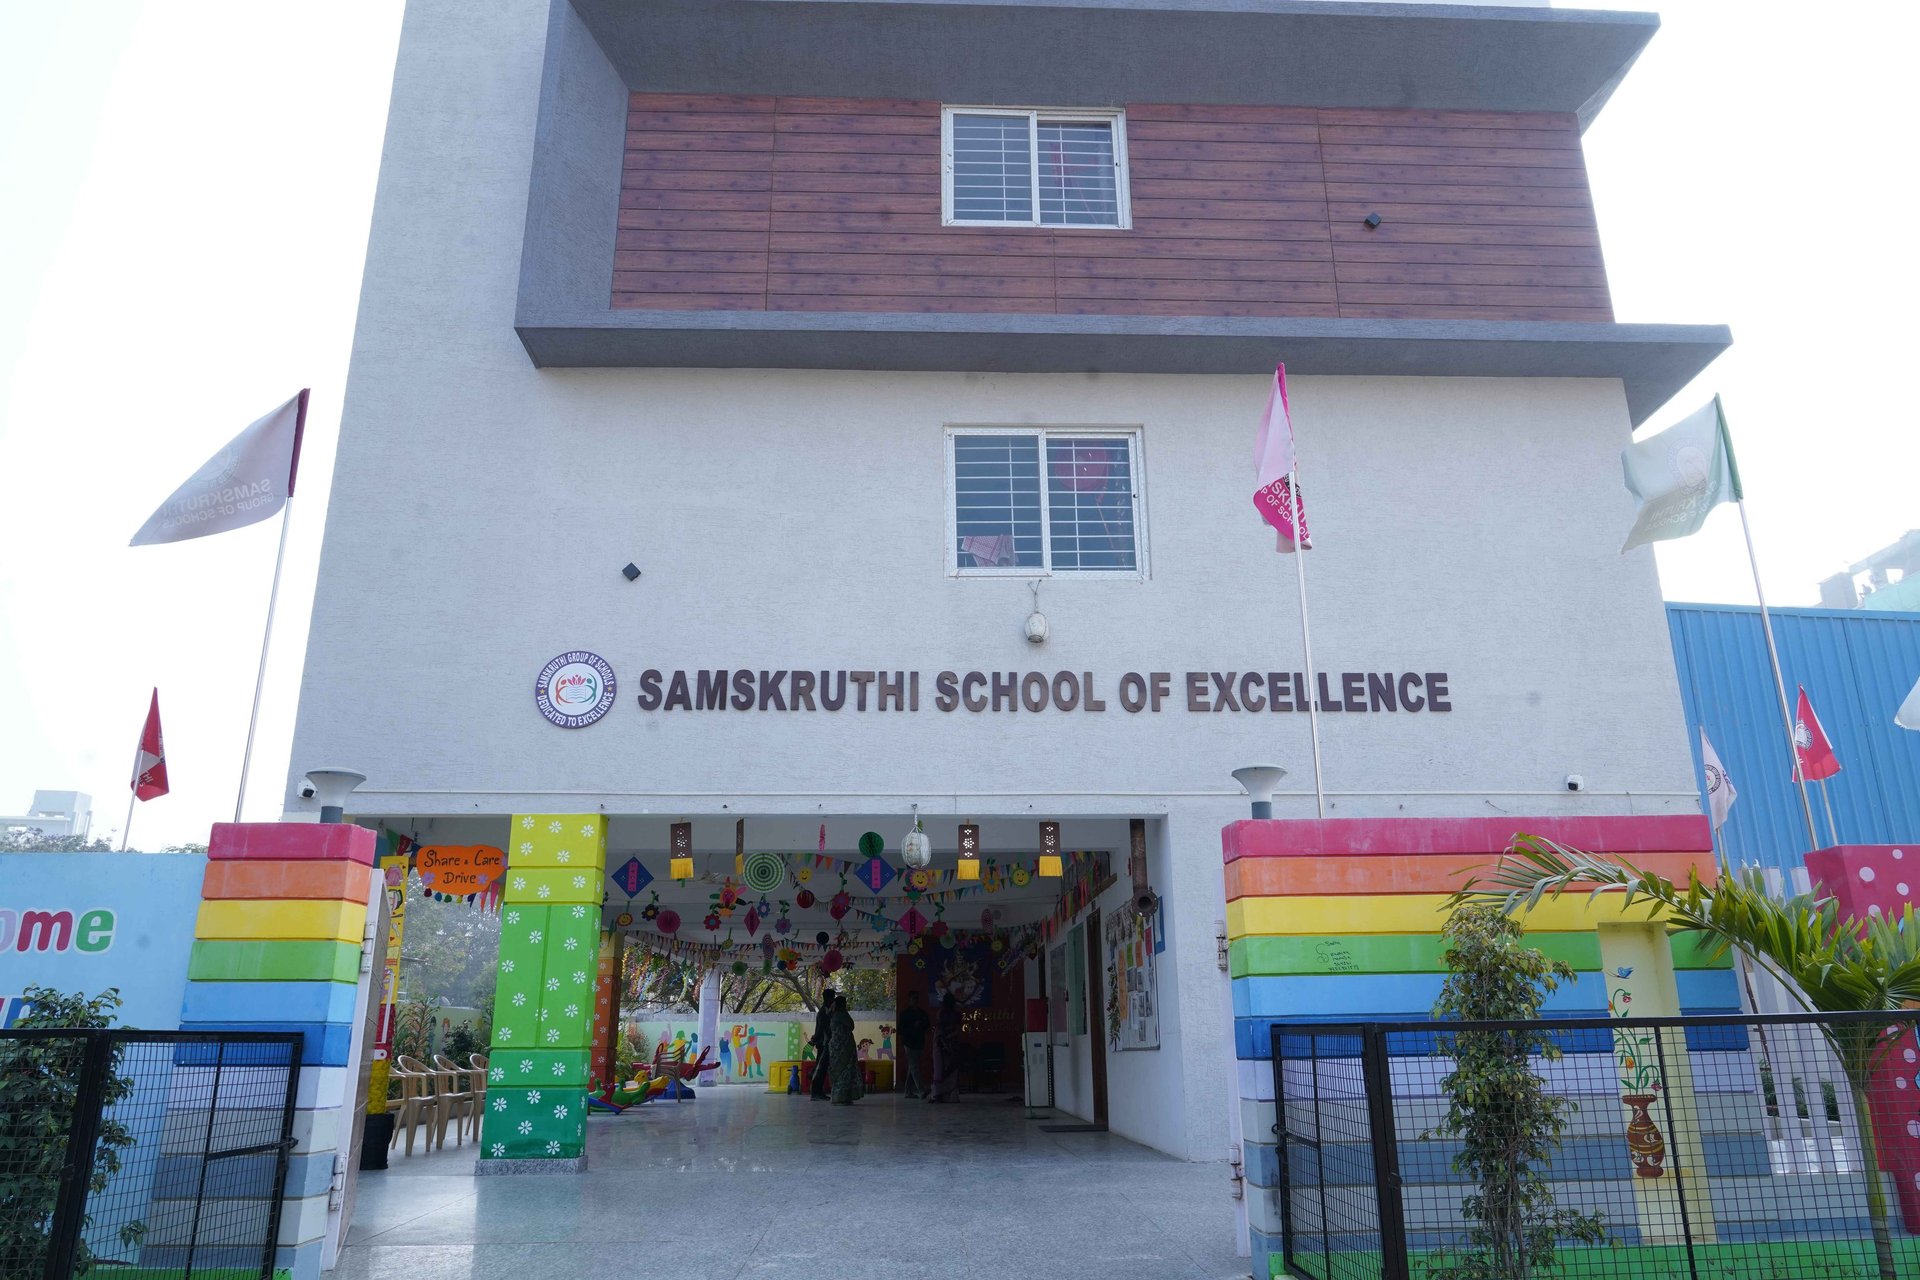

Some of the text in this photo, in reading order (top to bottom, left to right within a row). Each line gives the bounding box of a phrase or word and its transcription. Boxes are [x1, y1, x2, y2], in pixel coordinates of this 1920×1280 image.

[1266, 494, 1280, 508] OF
[537, 652, 615, 688] SAMSKRUTHI GROUP OF SCHOOLS
[637, 669, 1452, 713] SAMSKRUTHI SCHOOL OF EXCELLENCE
[537, 691, 614, 727] DEDICATED TO EXCELLENCE
[424, 849, 461, 868] Share
[474, 849, 500, 867] Care
[442, 872, 477, 884] Drive
